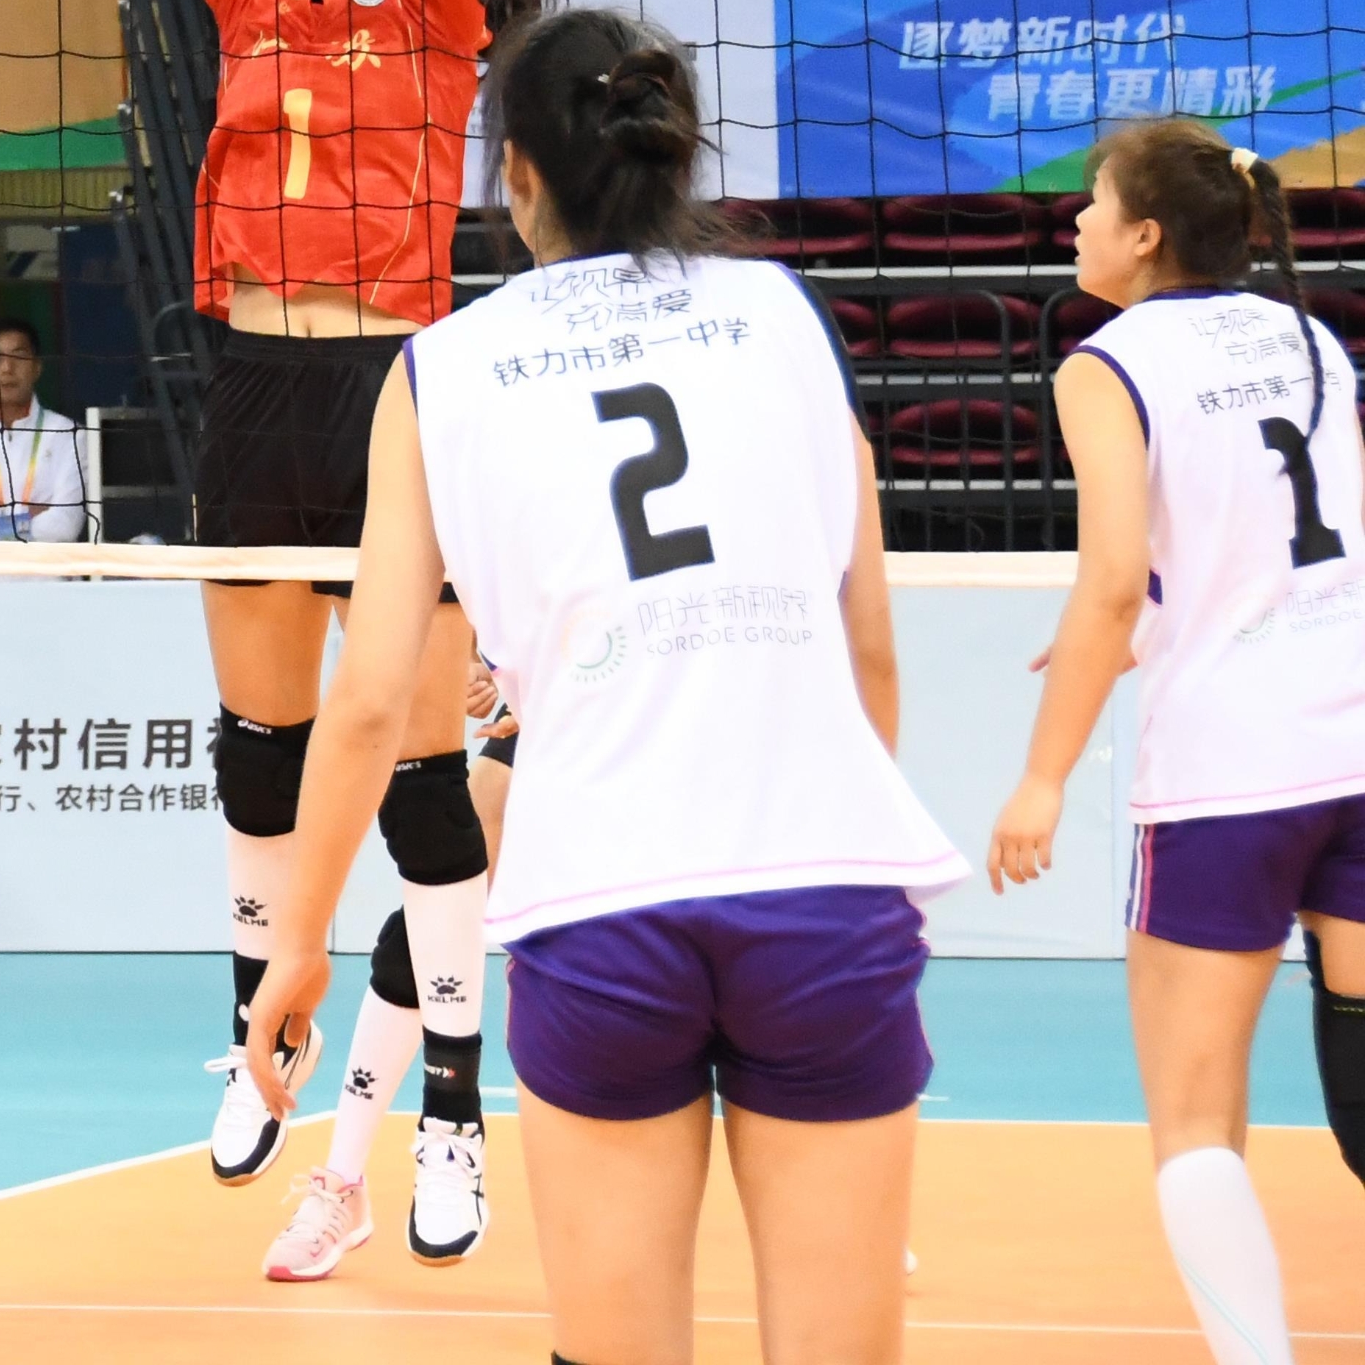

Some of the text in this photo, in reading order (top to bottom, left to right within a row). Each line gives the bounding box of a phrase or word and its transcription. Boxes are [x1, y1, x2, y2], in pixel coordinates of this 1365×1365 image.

[987, 64, 1277, 121] 青春更精彩
[283, 88, 313, 200] 1
[493, 317, 751, 387] 铁力市第一中学
[591, 381, 716, 582] 2
[1257, 416, 1347, 569] 1
[646, 626, 813, 659] SORDOE GROUP
[426, 994, 468, 1005] KELME
